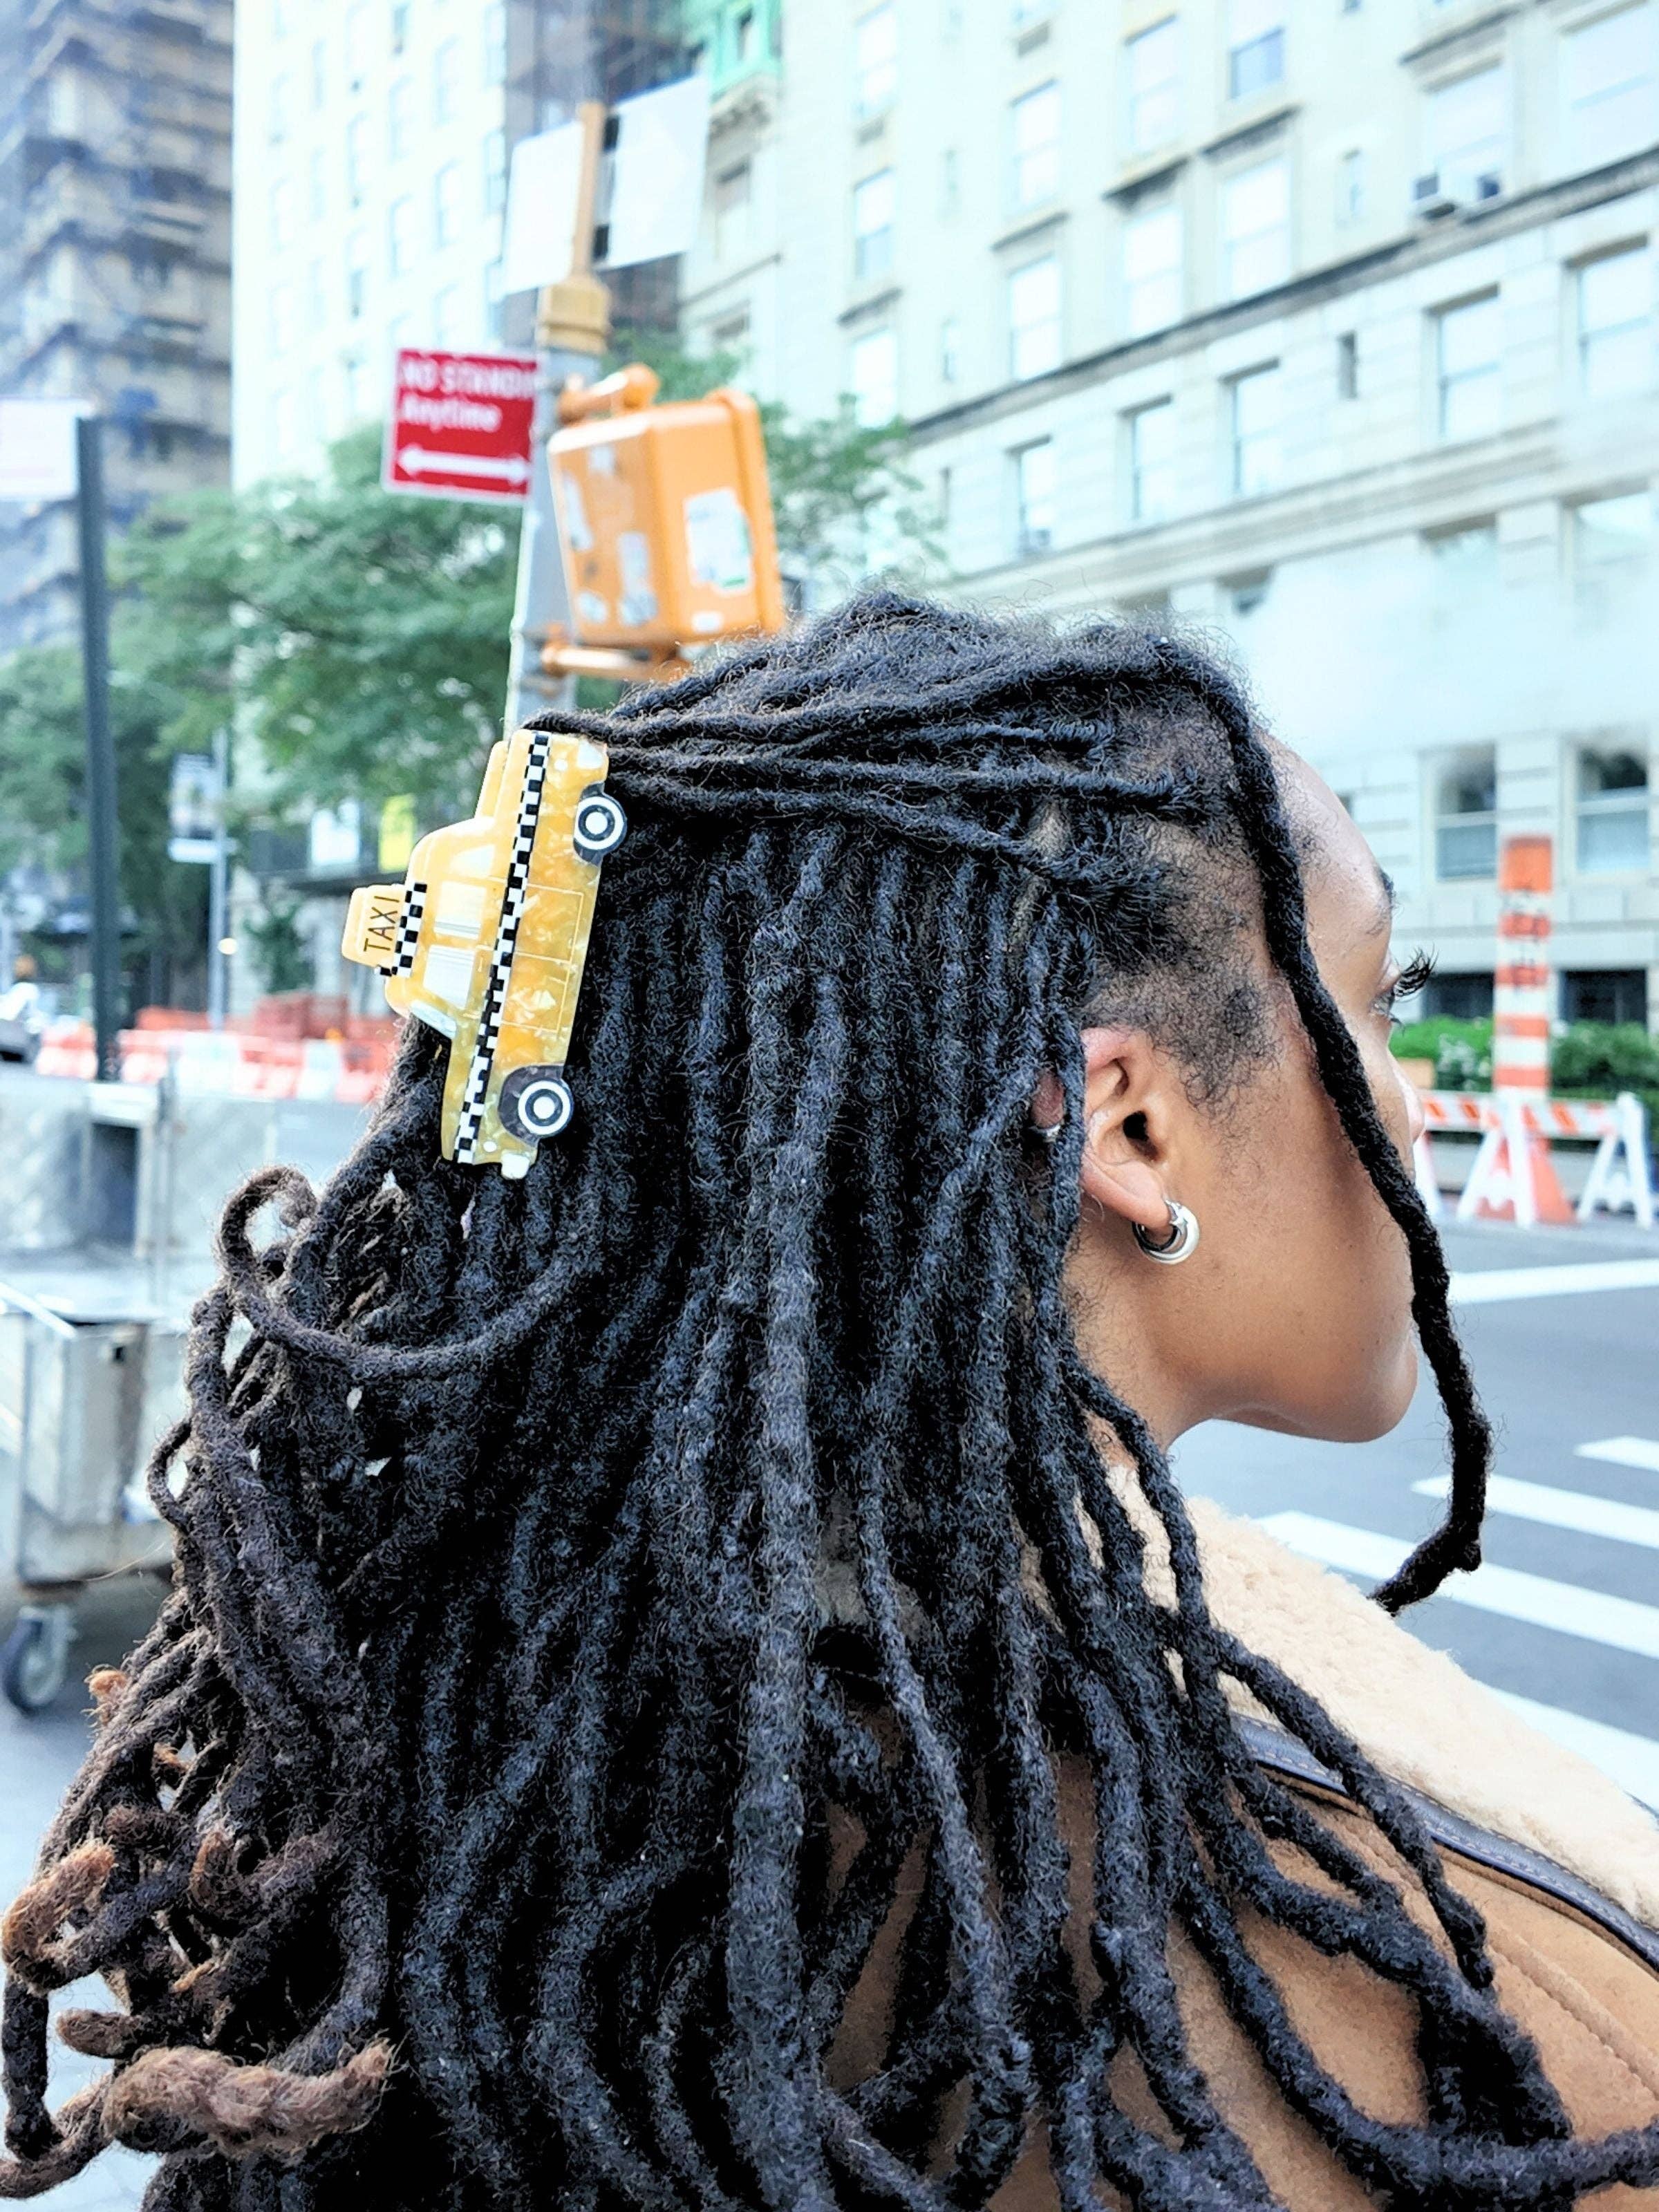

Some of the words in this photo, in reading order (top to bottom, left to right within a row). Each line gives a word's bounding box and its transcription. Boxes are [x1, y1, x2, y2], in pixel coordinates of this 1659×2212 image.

[402, 359, 438, 392] NO
[440, 359, 535, 398] STANDI
[363, 895, 400, 952] TAXI
